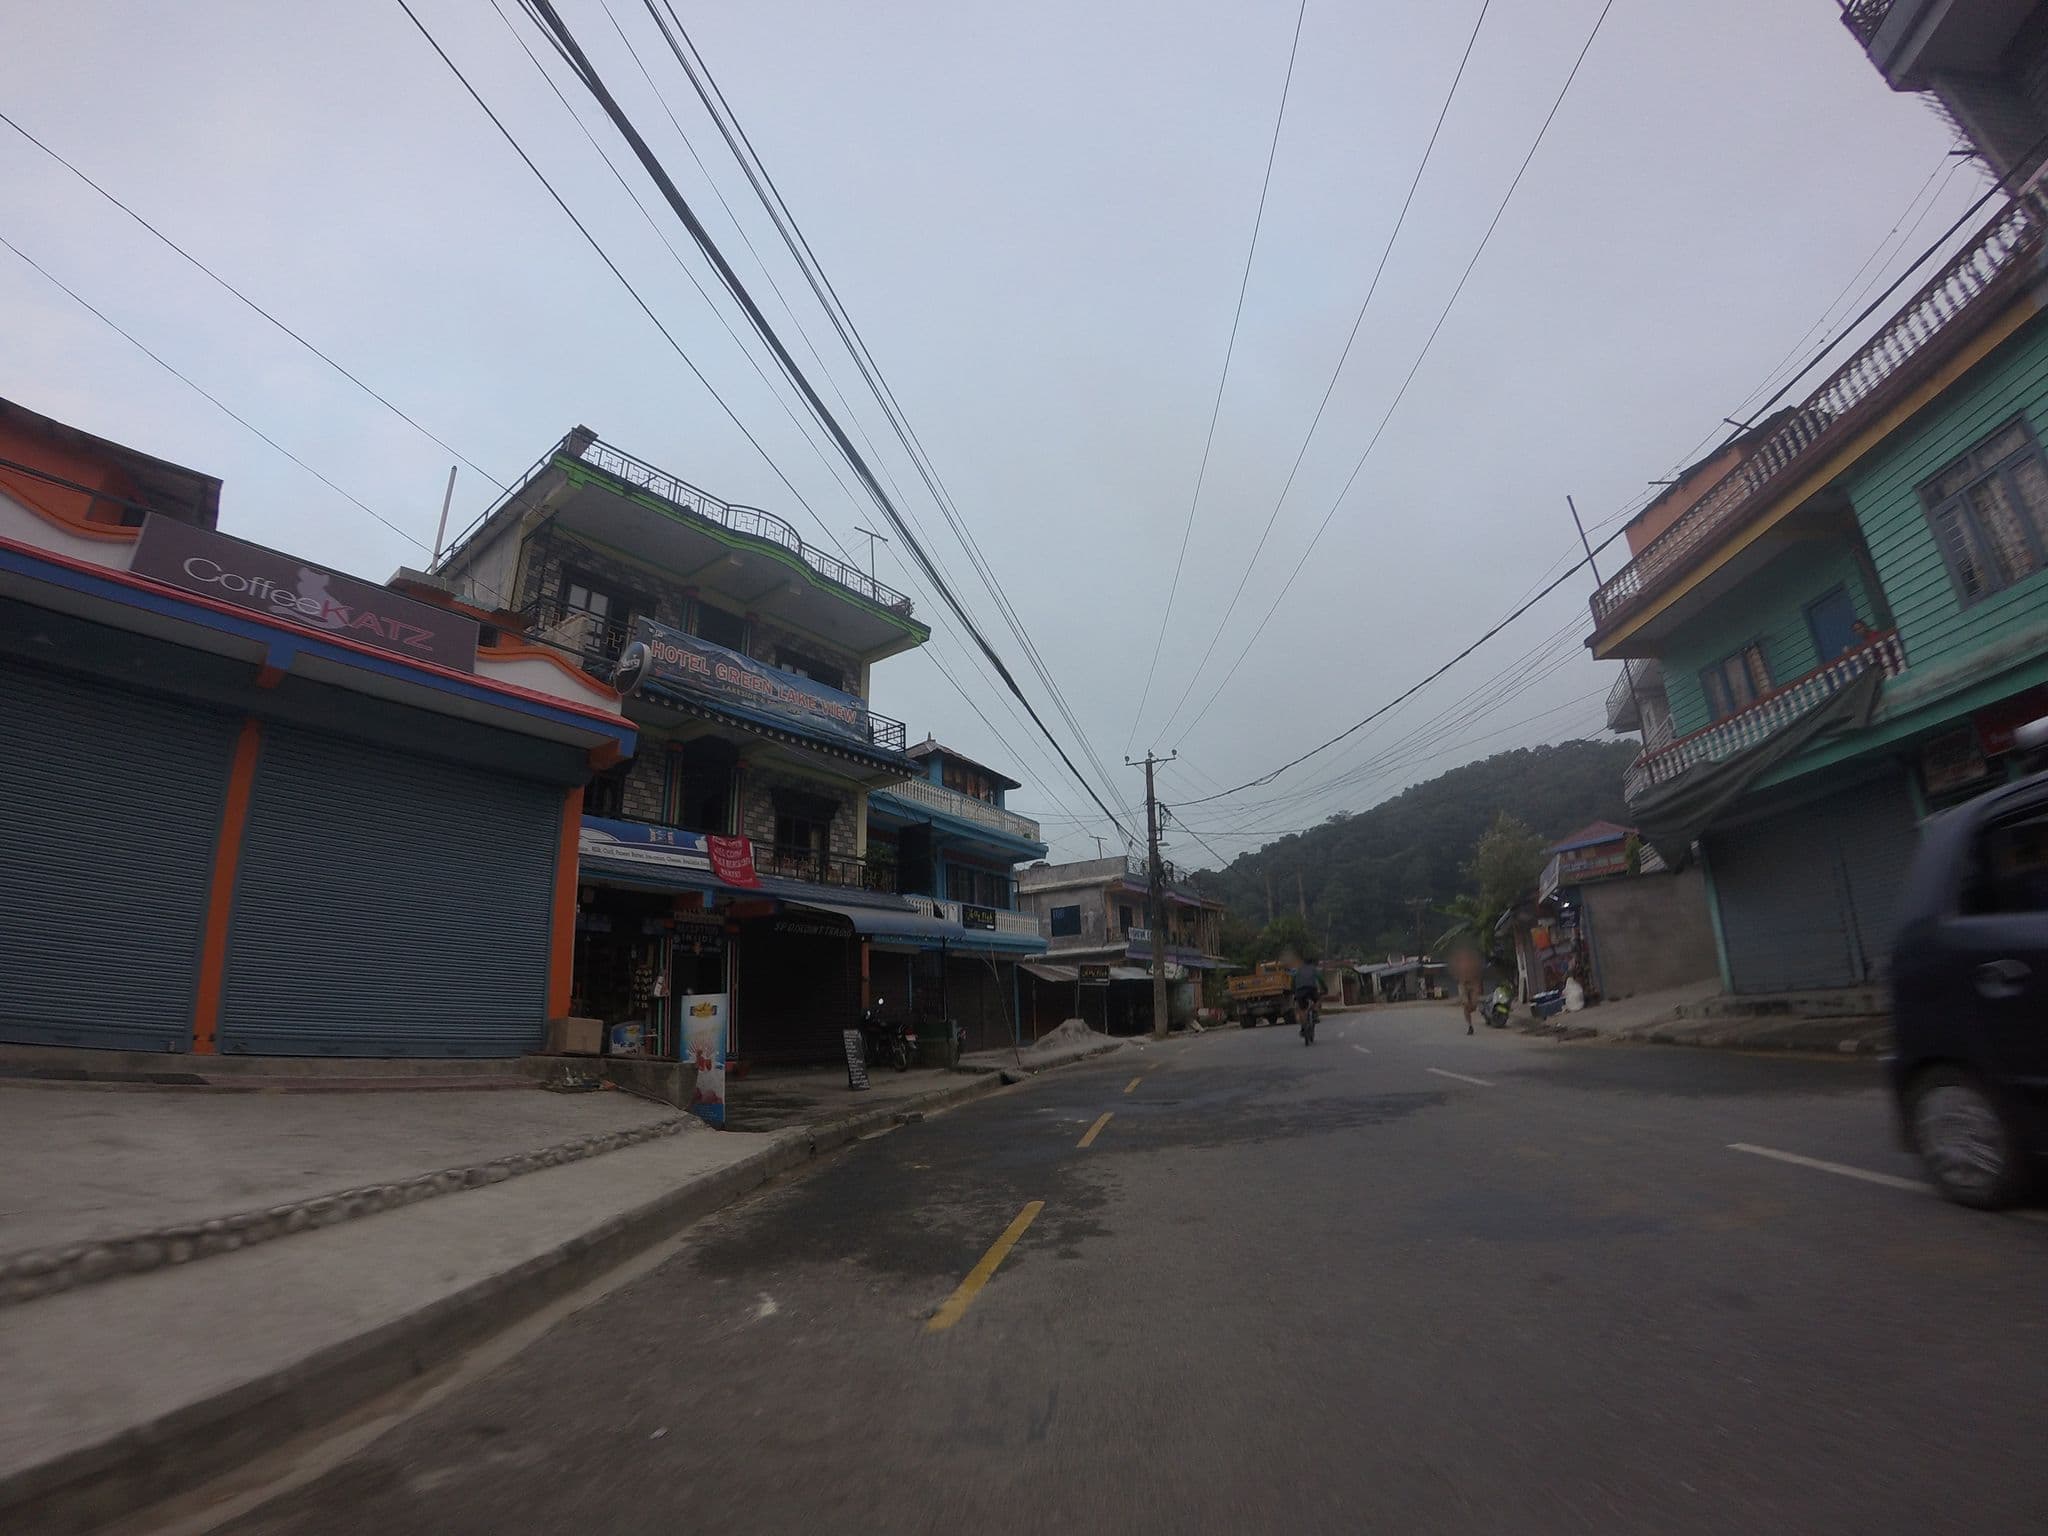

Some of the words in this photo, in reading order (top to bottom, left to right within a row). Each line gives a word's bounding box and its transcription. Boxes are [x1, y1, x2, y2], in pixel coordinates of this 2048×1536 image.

[651, 639, 710, 676] HOTEL
[715, 662, 773, 696] GREEN
[777, 684, 817, 711] LAKE
[821, 699, 857, 725] VIEW
